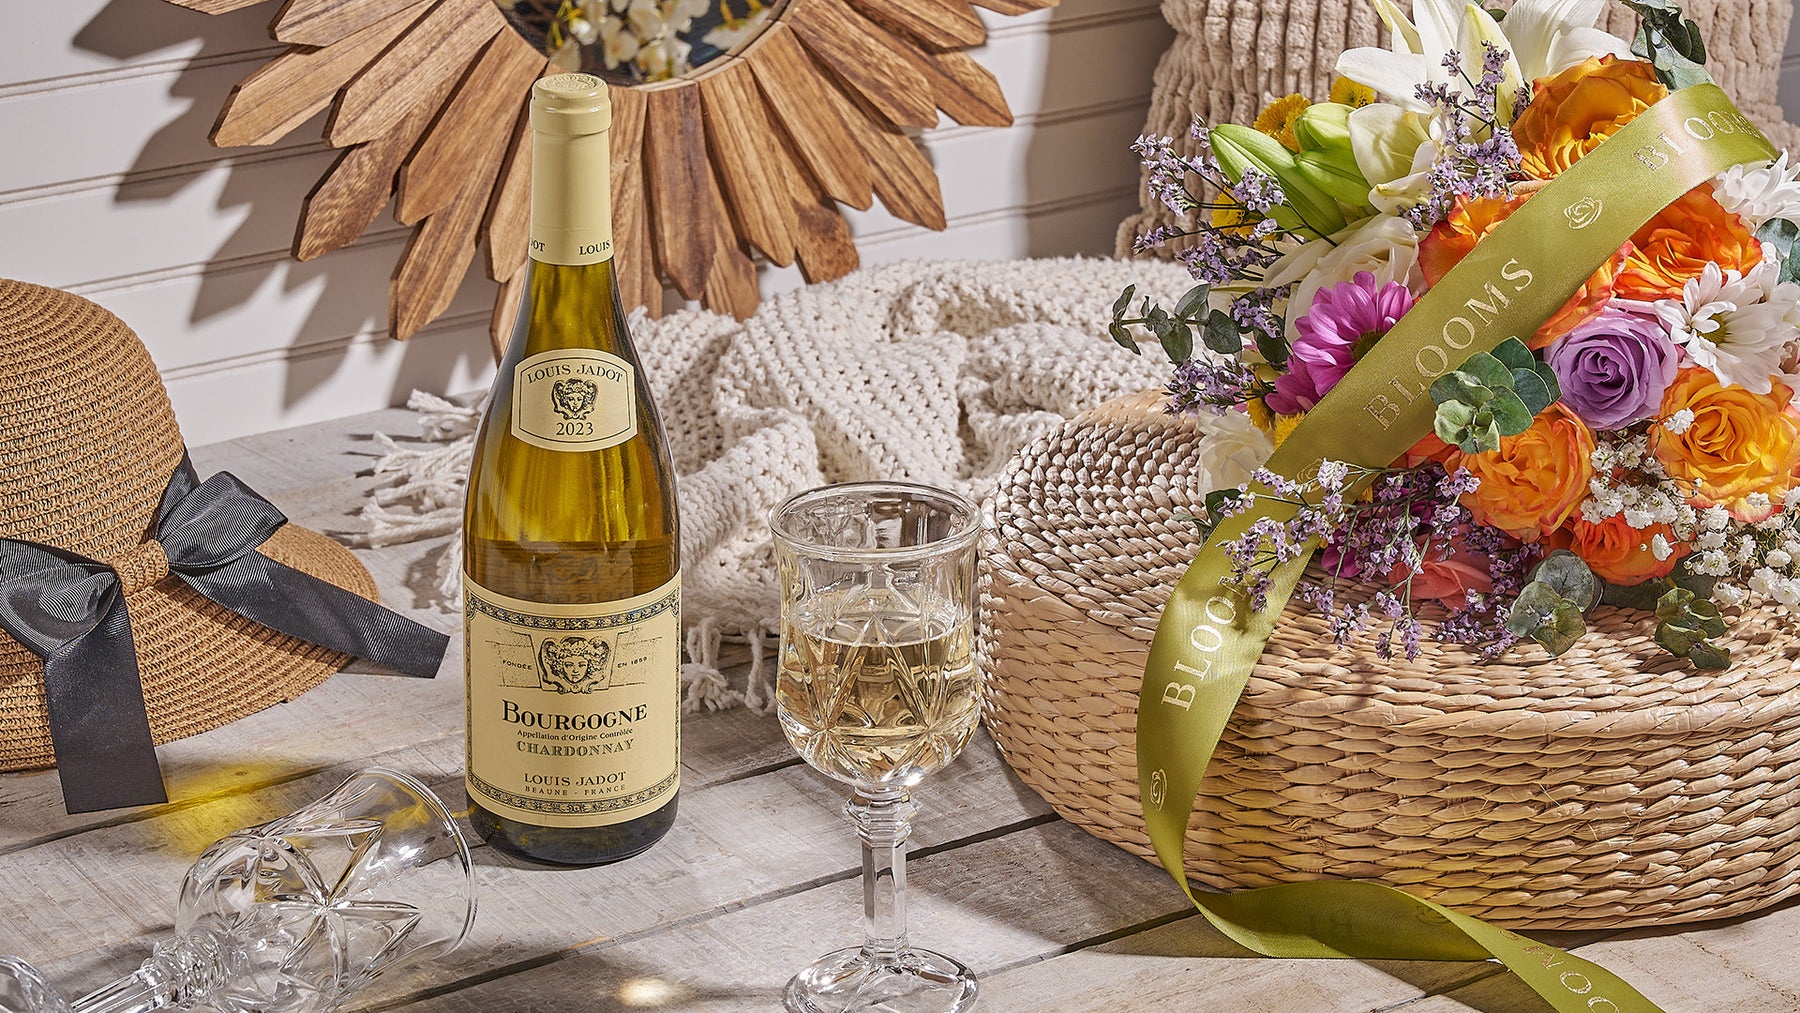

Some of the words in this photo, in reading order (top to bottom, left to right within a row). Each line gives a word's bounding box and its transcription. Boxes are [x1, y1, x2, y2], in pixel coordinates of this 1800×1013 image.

[578, 239, 611, 256] LOUIS
[1362, 257, 1534, 431] BLOOMS
[527, 364, 571, 384] LOUIS
[576, 364, 623, 383] JADOT
[556, 422, 594, 436] 2023
[1160, 552, 1264, 712] BLOO
[617, 661, 628, 669] EN
[501, 699, 648, 731] BOURGOGNE
[517, 729, 560, 741] Appellation
[561, 734, 598, 742] d'Origine
[599, 728, 634, 740] Contrôlée
[516, 739, 634, 756] CHARDONNAY
[524, 772, 571, 787] LOUIS
[575, 771, 627, 787] JADOT
[525, 786, 568, 796] BEAUNE
[584, 784, 626, 796] FRANCE
